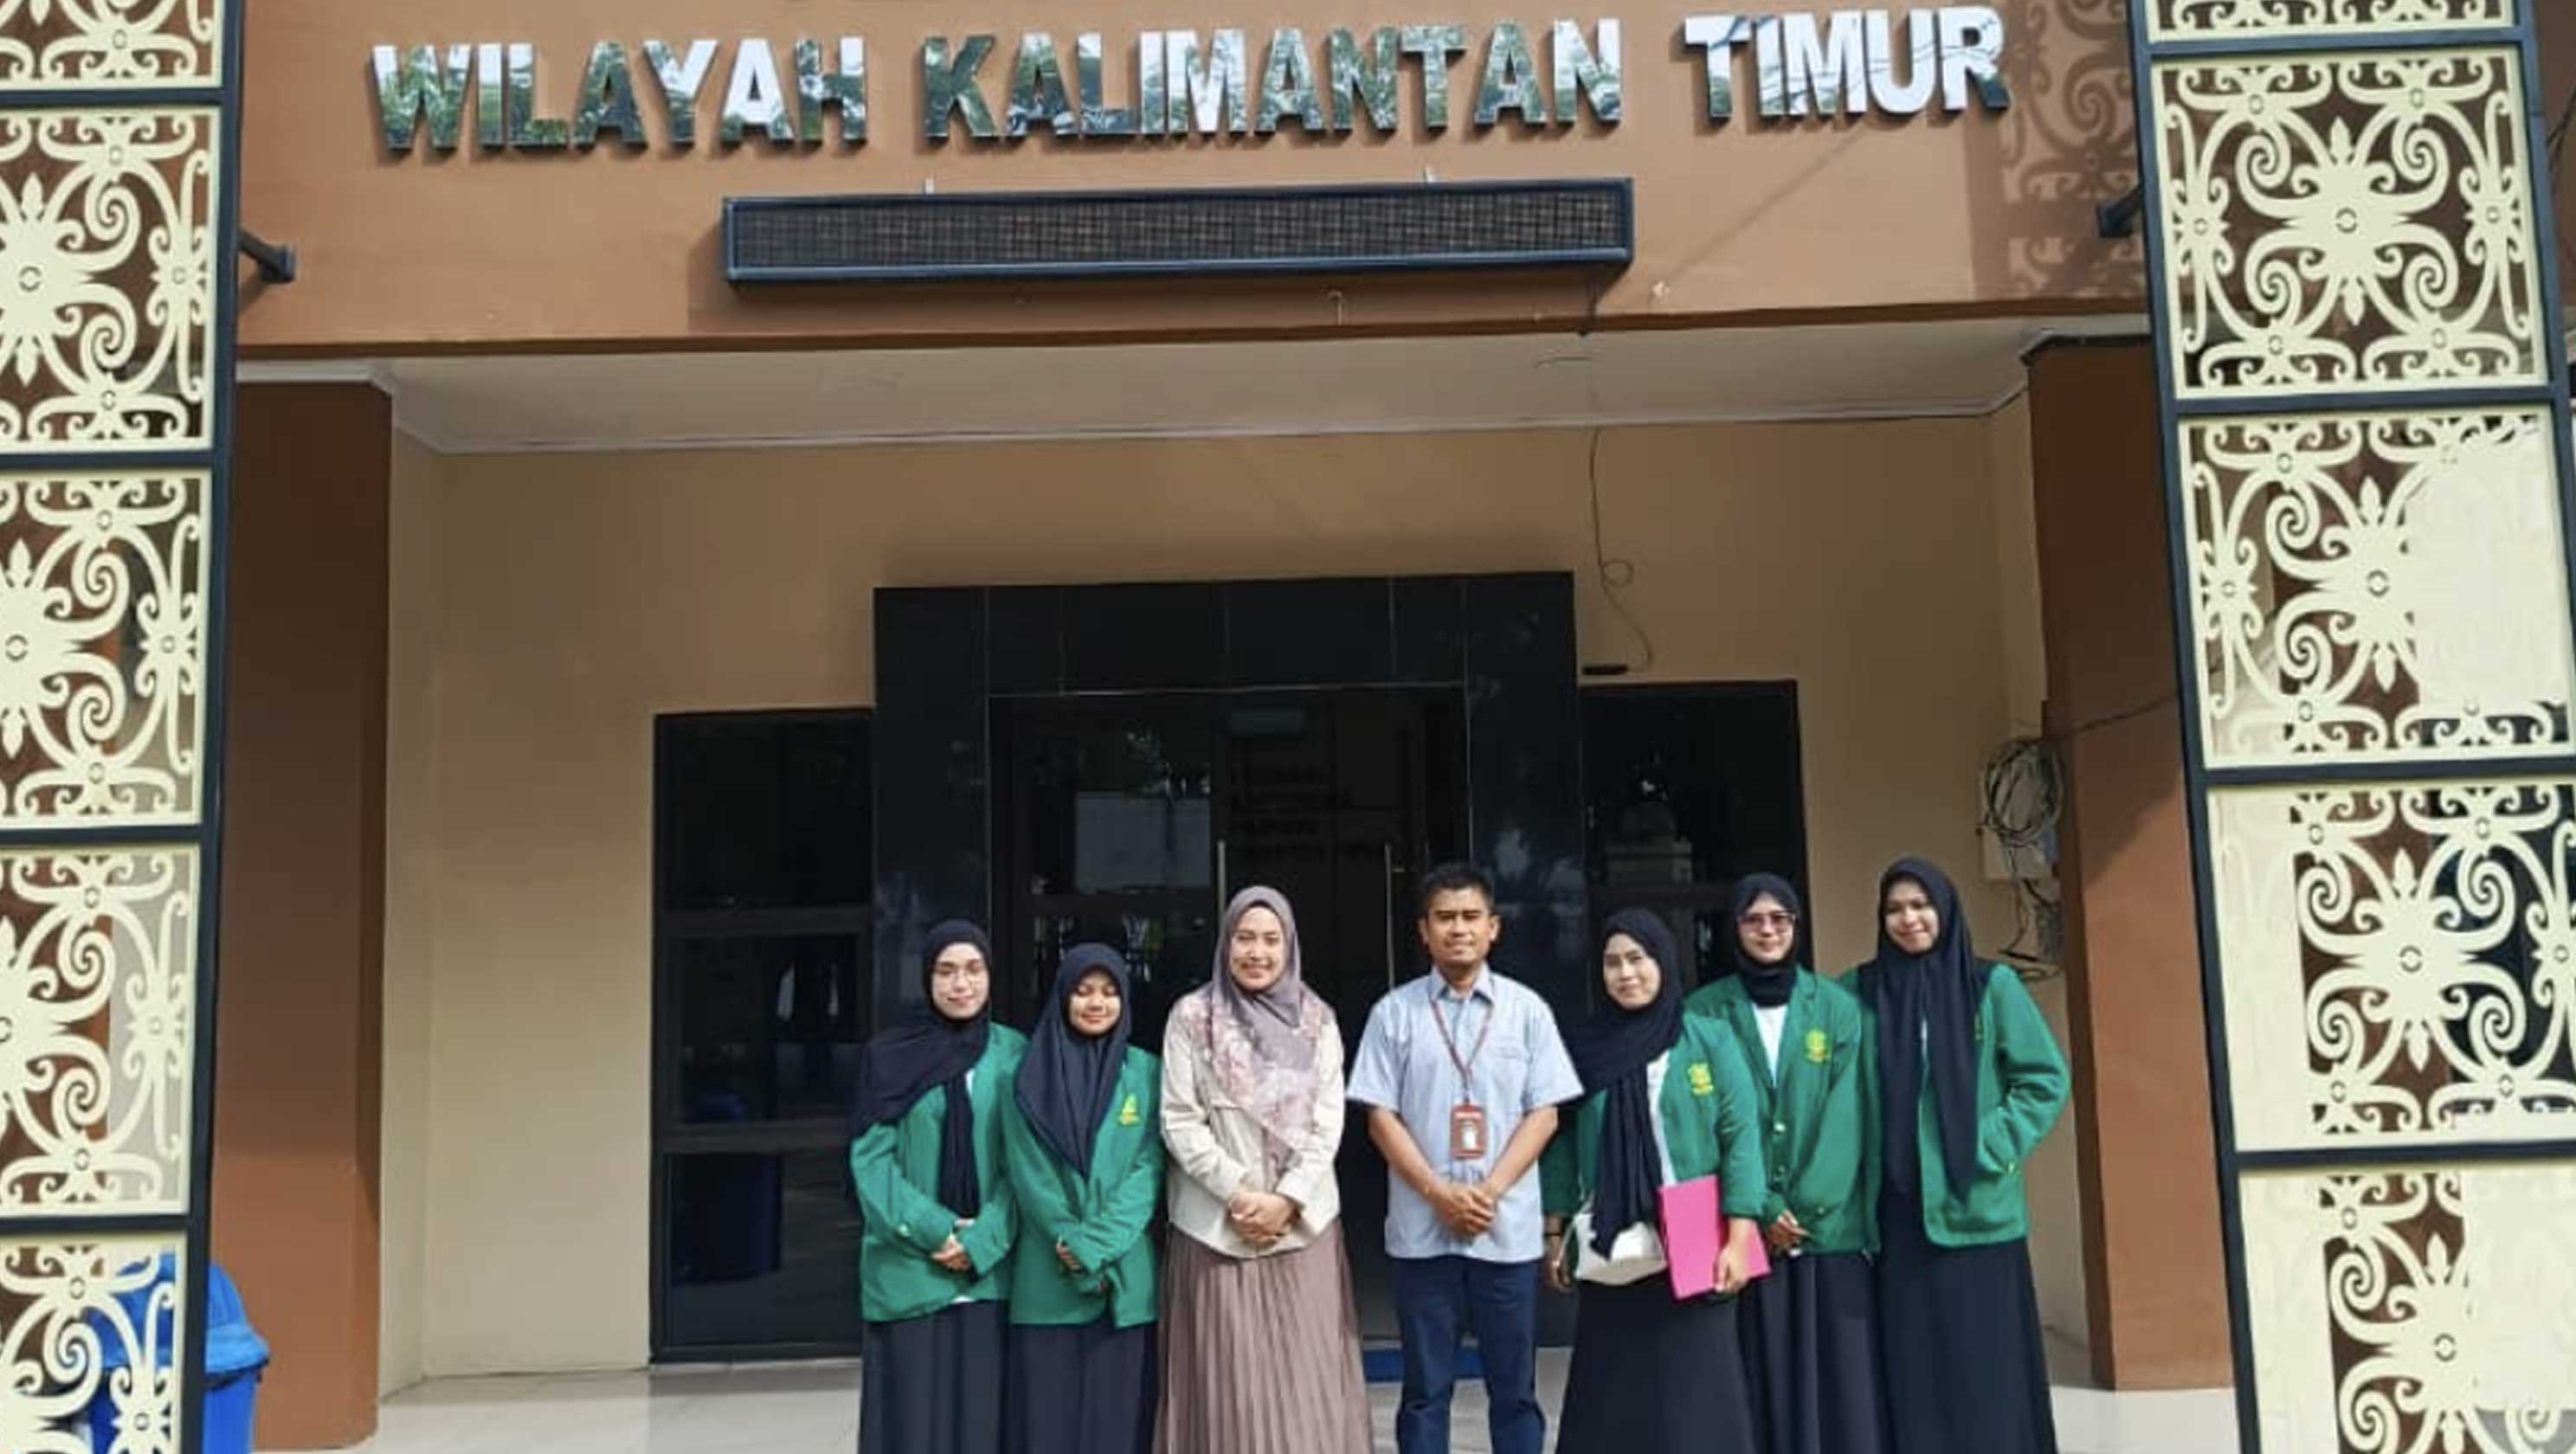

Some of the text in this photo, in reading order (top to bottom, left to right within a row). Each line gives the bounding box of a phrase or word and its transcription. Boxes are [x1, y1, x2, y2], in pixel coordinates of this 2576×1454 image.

[371, 5, 2011, 149] WILAYAH KALIMANTAN TIMUR
